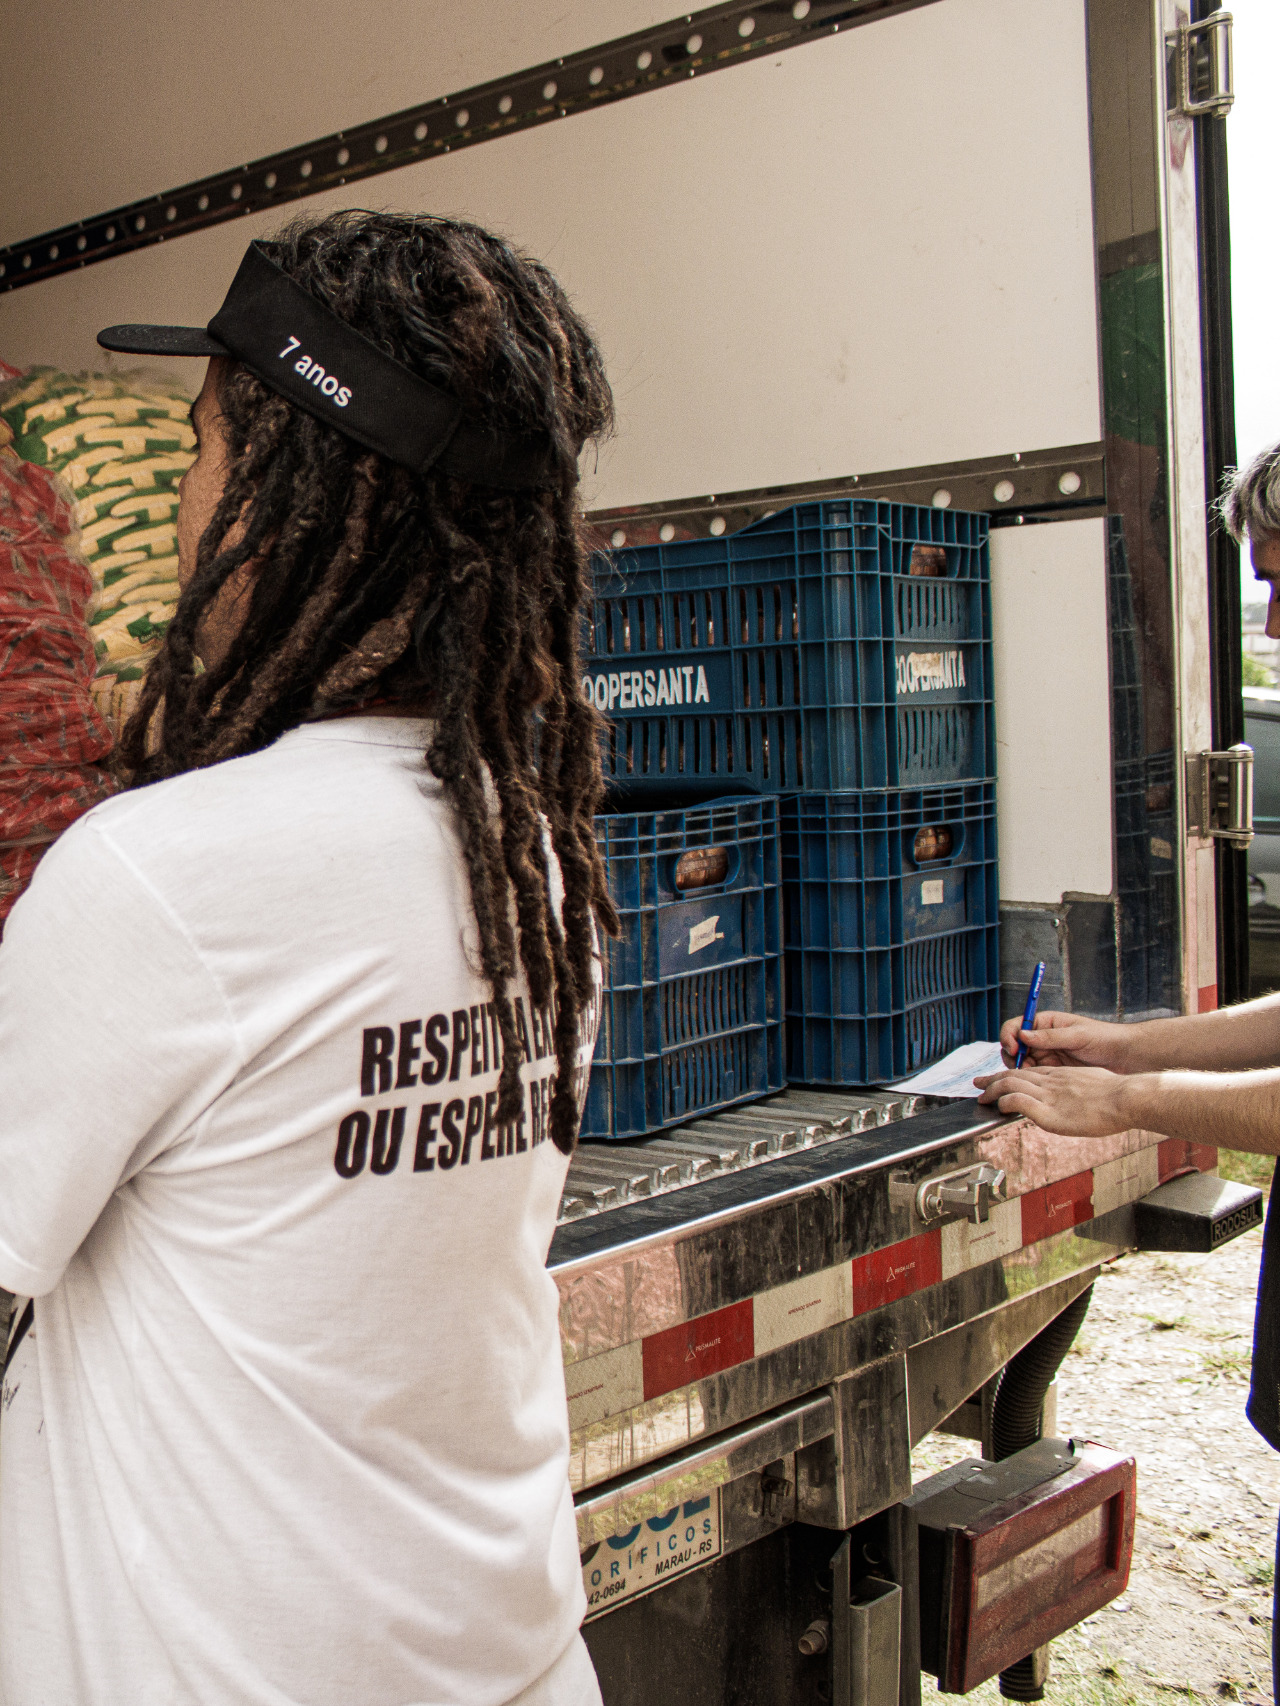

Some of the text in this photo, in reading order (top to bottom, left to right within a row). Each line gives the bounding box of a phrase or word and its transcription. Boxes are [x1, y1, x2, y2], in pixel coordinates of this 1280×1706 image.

[278, 335, 353, 408] 7 anos
[334, 1106, 407, 1180] OU
[1214, 1203, 1259, 1241] RODOSUL
[695, 1337, 721, 1352] PRISMALITE
[587, 1578, 626, 1606] 42-0694
